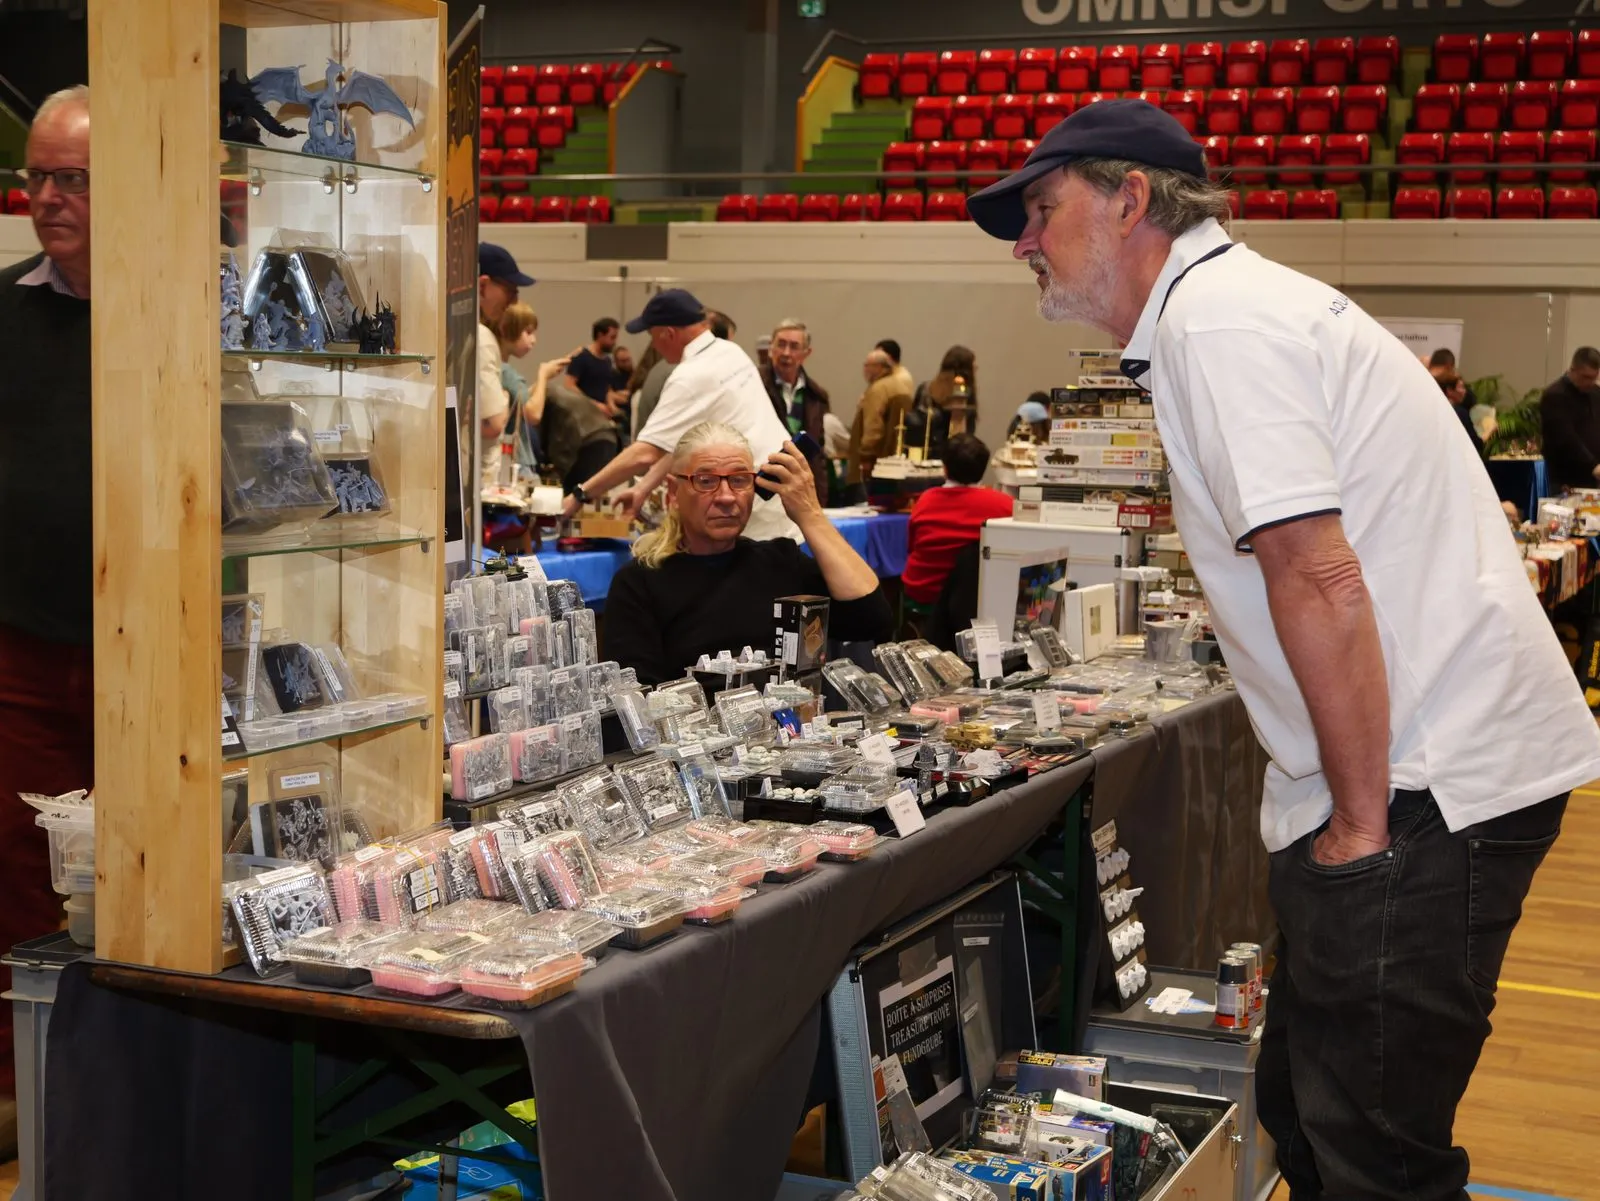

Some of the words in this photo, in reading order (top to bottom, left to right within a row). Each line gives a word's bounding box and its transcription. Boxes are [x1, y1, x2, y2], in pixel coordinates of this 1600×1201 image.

[916, 981, 952, 1012] SURPRISES
[890, 1016, 929, 1049] TREASURE
[929, 1002, 951, 1026] TROVE
[902, 1030, 944, 1066] FUNDGRUBE
